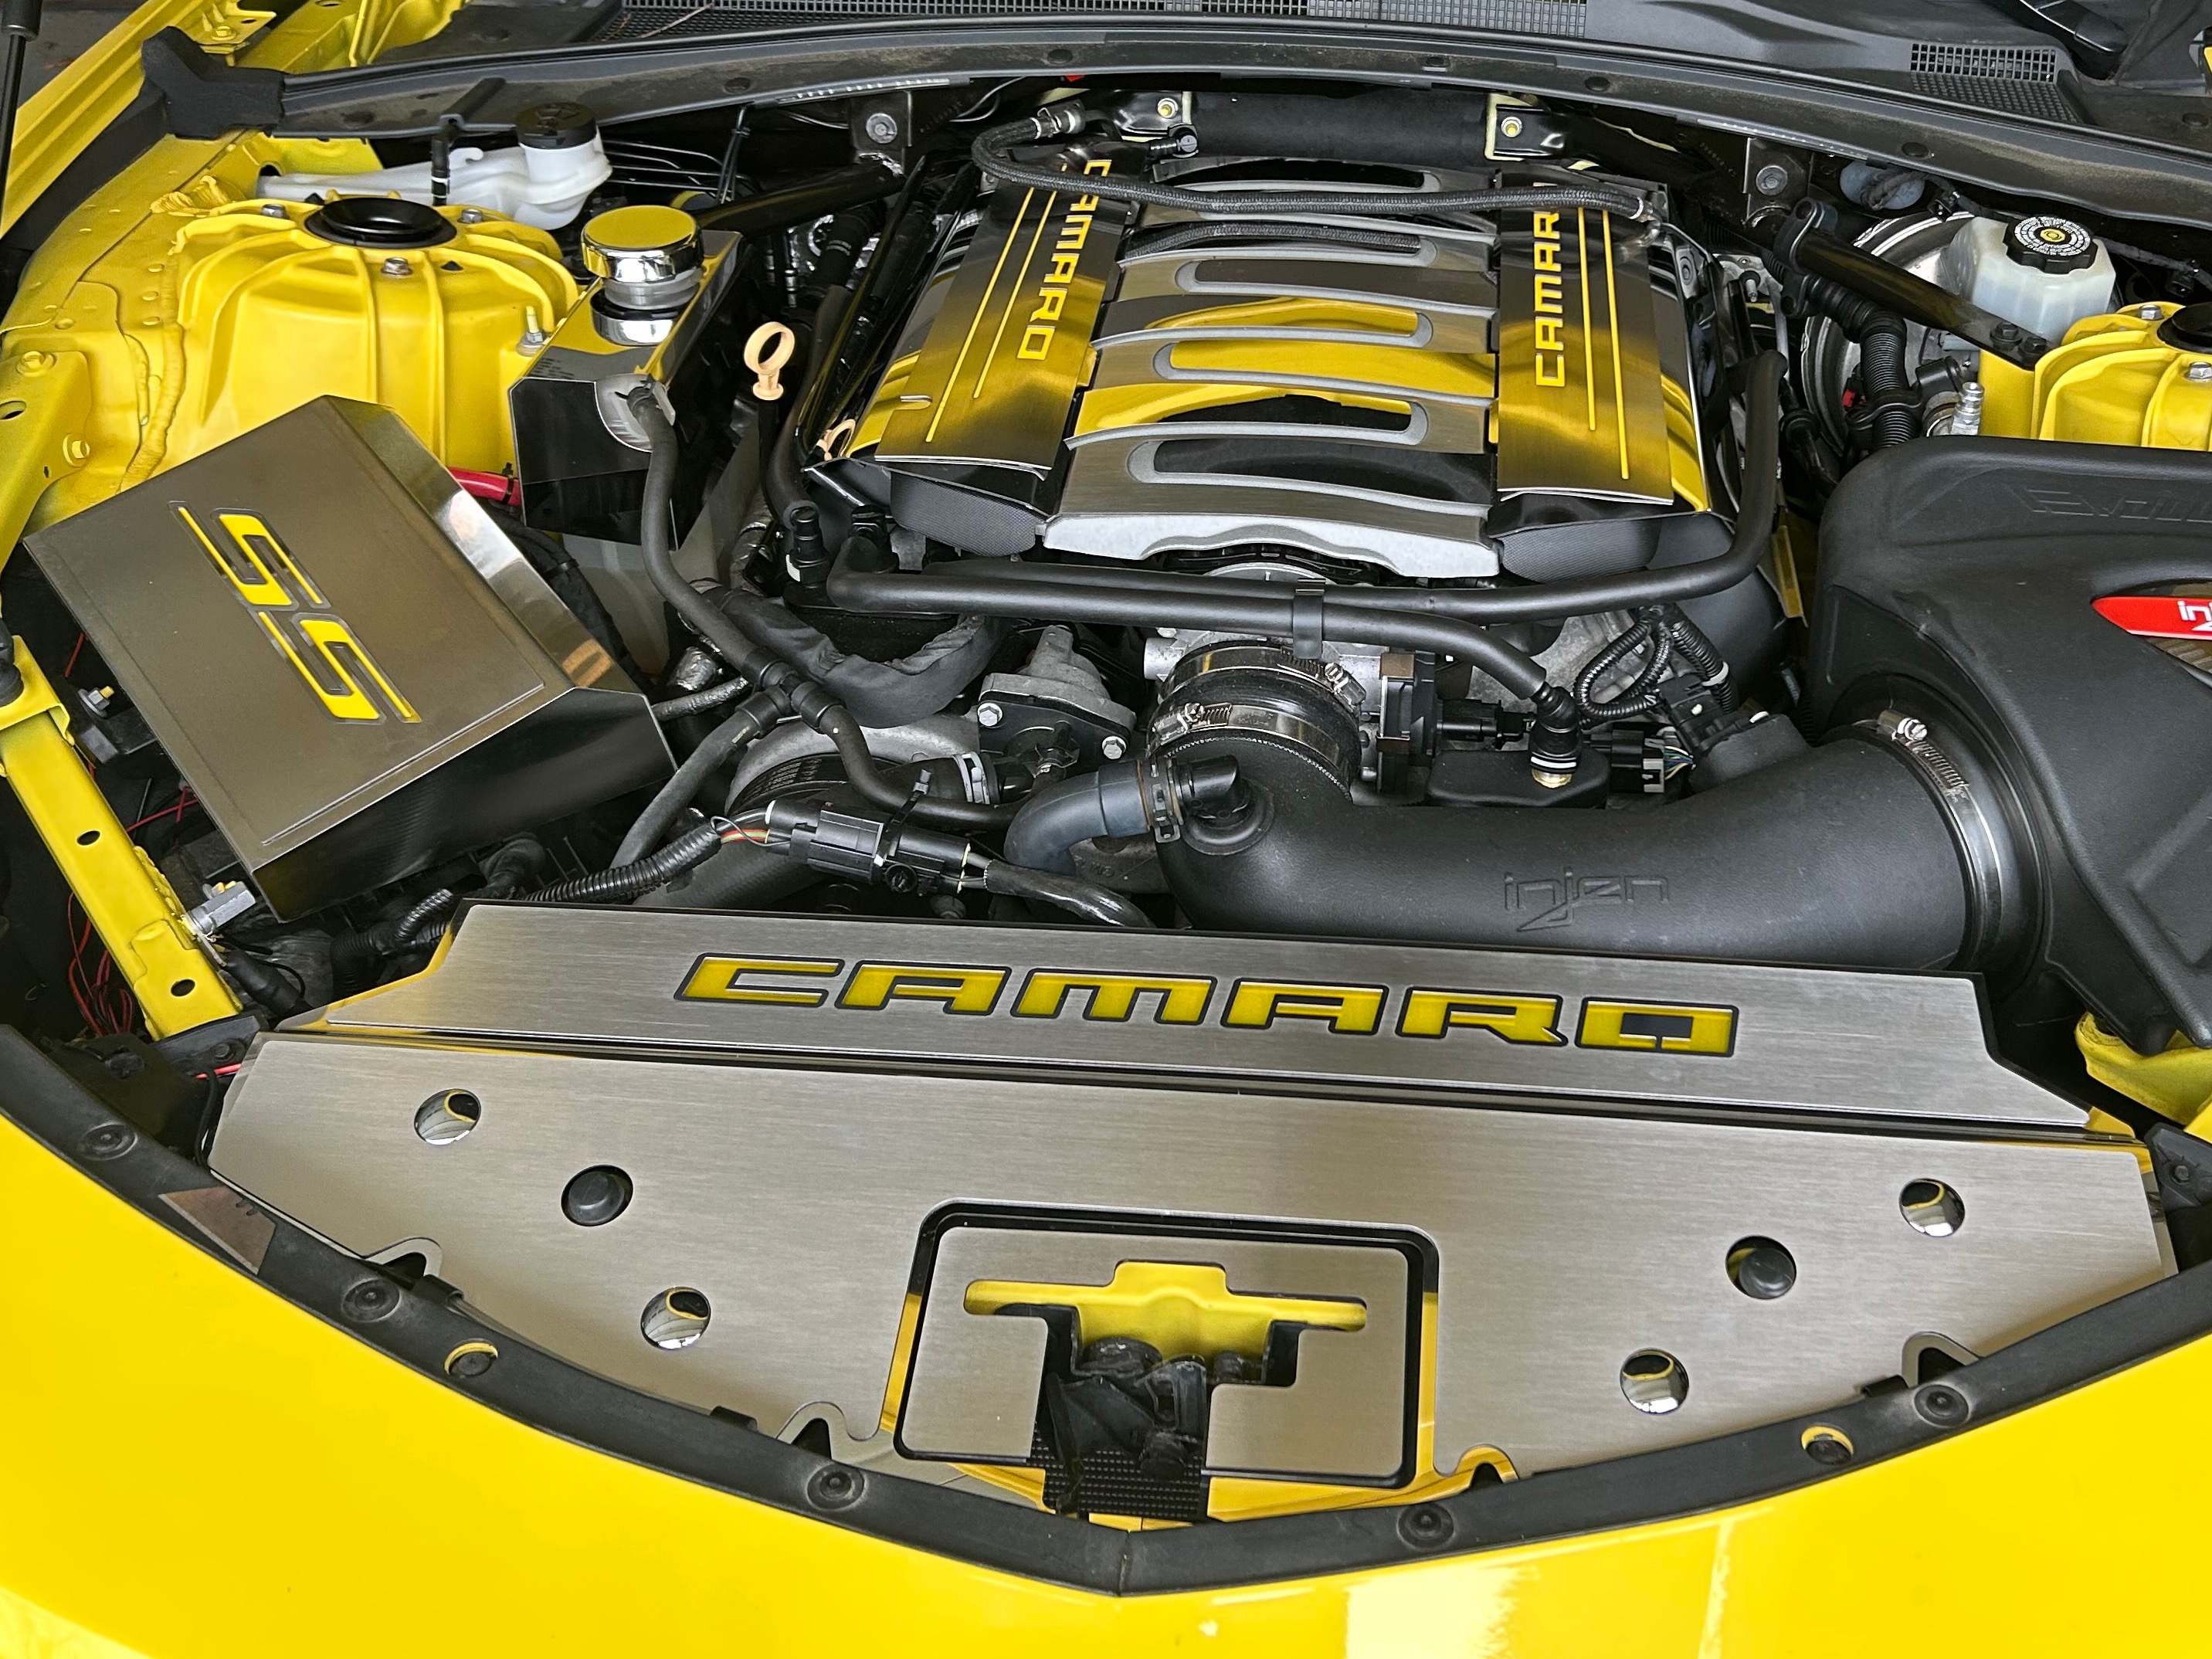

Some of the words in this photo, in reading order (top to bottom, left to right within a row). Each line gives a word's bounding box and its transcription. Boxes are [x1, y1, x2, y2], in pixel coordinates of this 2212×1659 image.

[1533, 182, 1566, 387] CAMAR
[173, 504, 417, 723] SS
[674, 952, 1739, 1057] CAMARO
